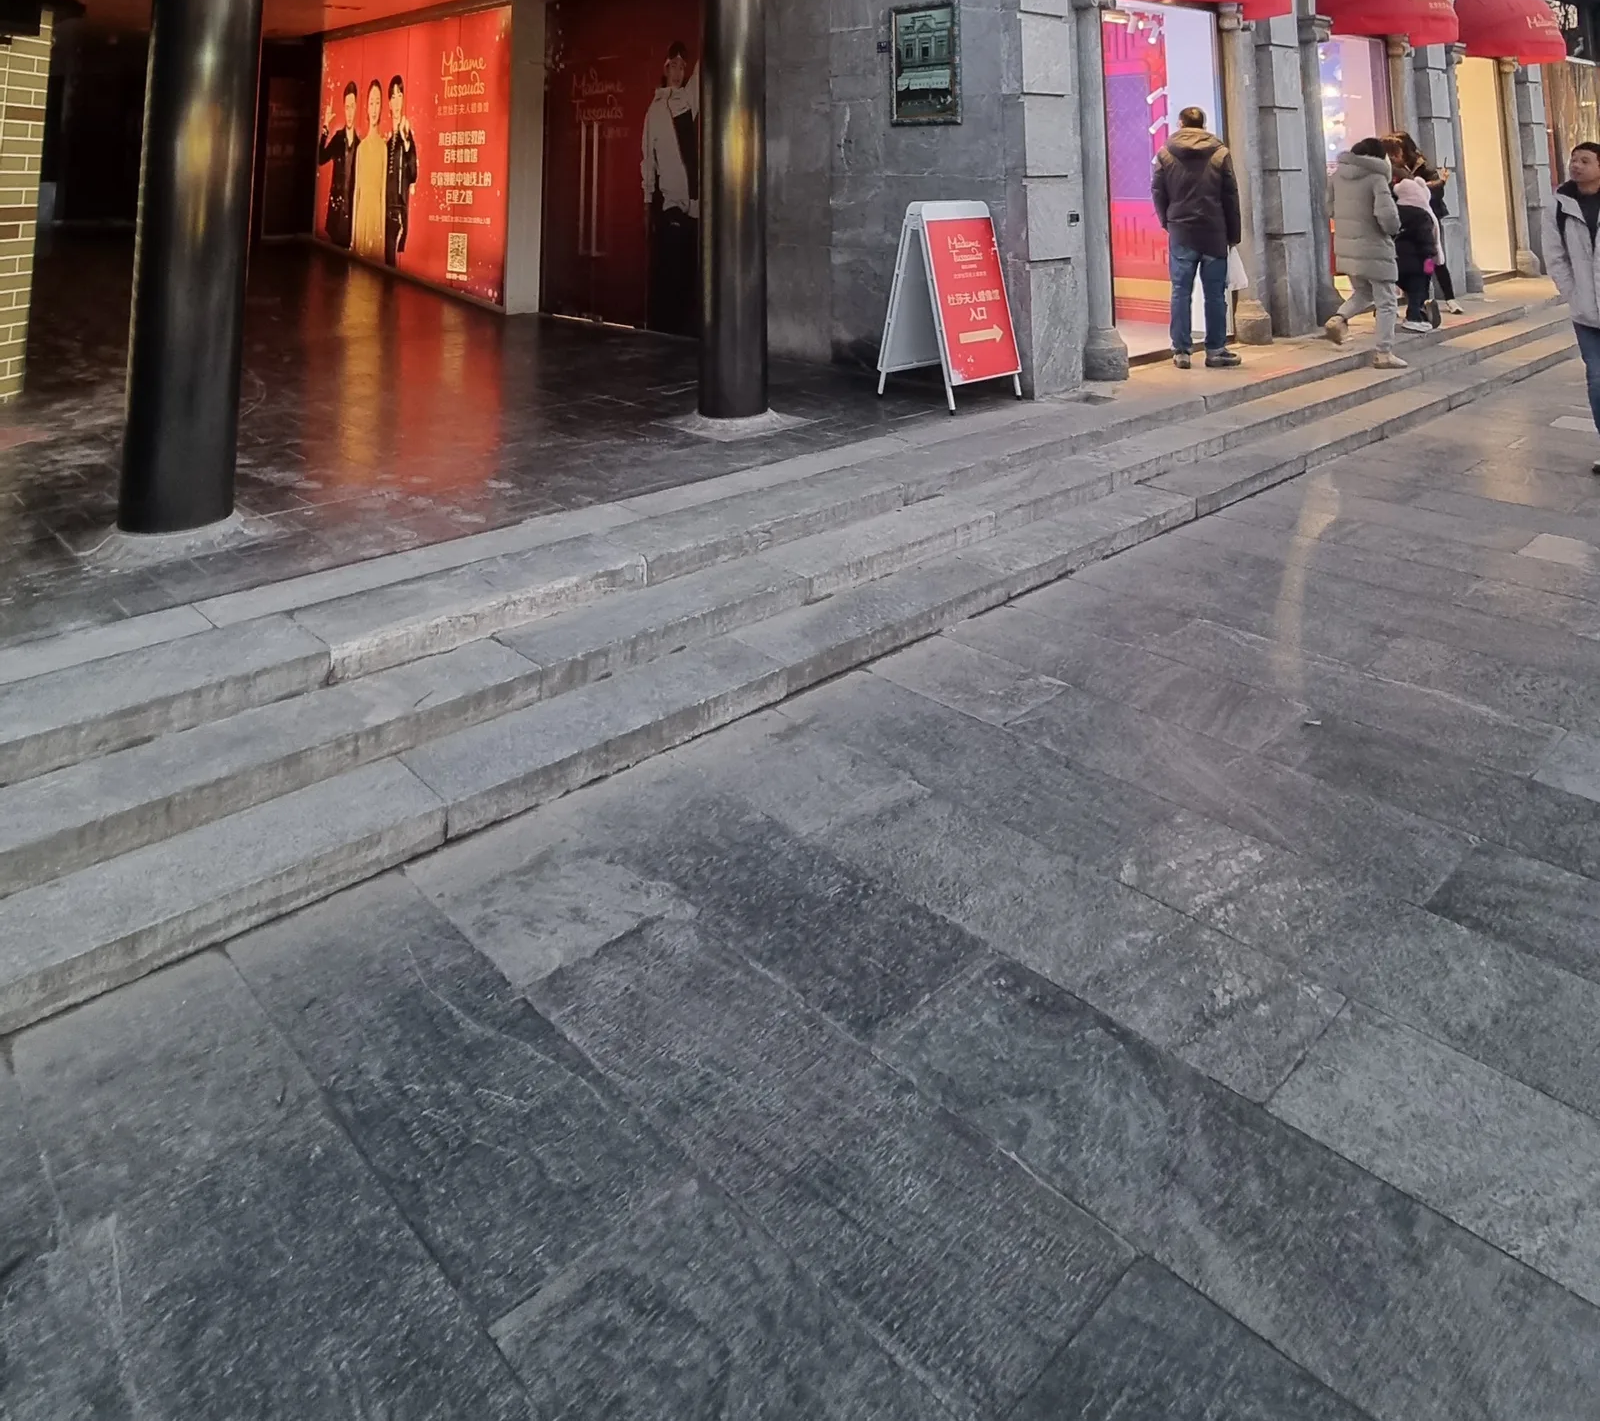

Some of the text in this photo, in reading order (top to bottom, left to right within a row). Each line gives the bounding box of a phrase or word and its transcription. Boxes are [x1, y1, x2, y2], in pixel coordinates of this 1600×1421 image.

[441, 45, 487, 76] Madame
[440, 70, 486, 99] Tussauds
[969, 307, 987, 322] 入口
